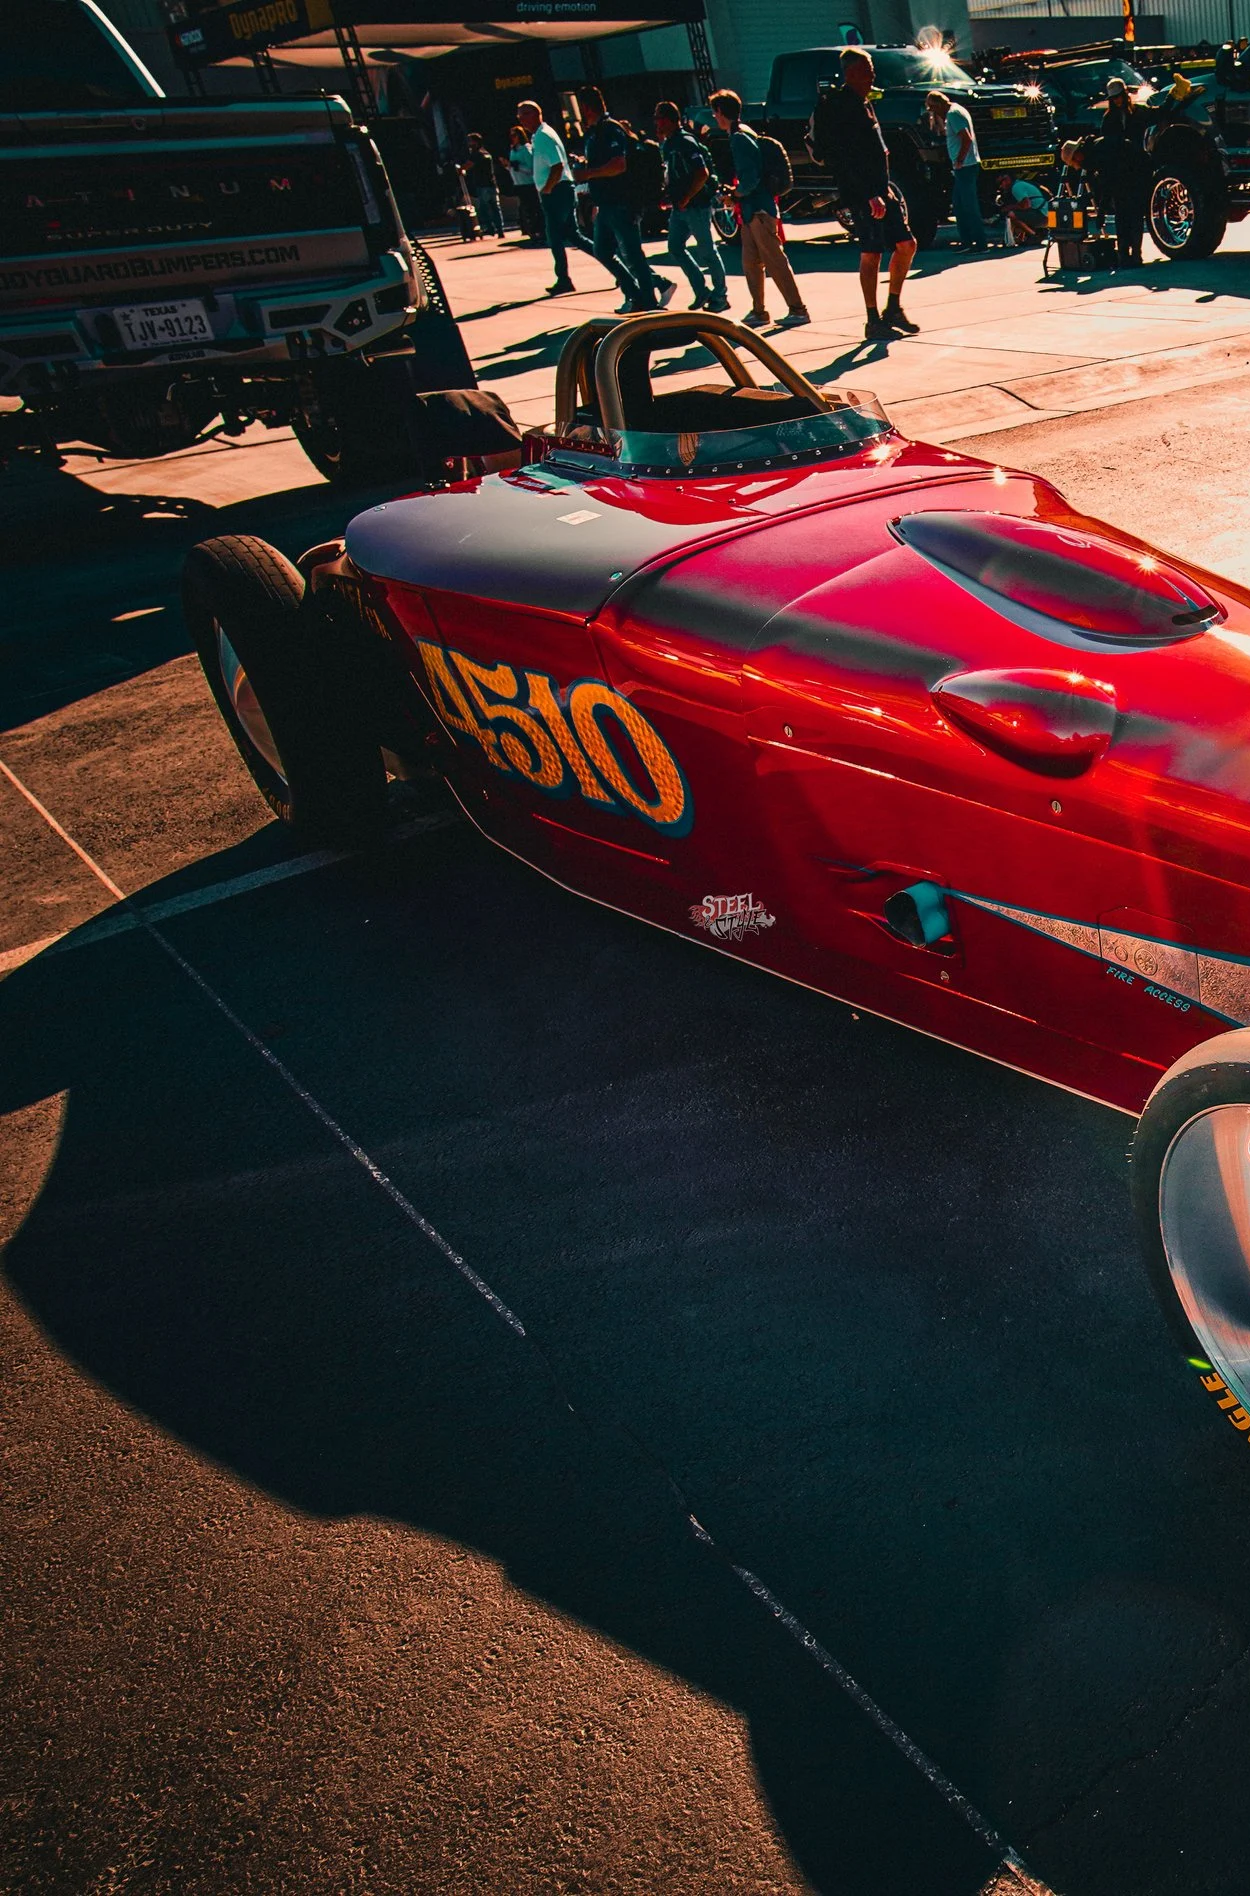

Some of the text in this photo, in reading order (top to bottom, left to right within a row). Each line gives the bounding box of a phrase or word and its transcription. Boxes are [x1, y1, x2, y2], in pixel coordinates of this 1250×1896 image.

[516, 2, 597, 14] driving emotion
[147, 221, 213, 234] DUTY
[142, 305, 178, 317] TEXAS
[417, 639, 692, 834] 4510
[701, 892, 762, 918] STEEL
[1106, 965, 1191, 1012] FIRE ACCESS
